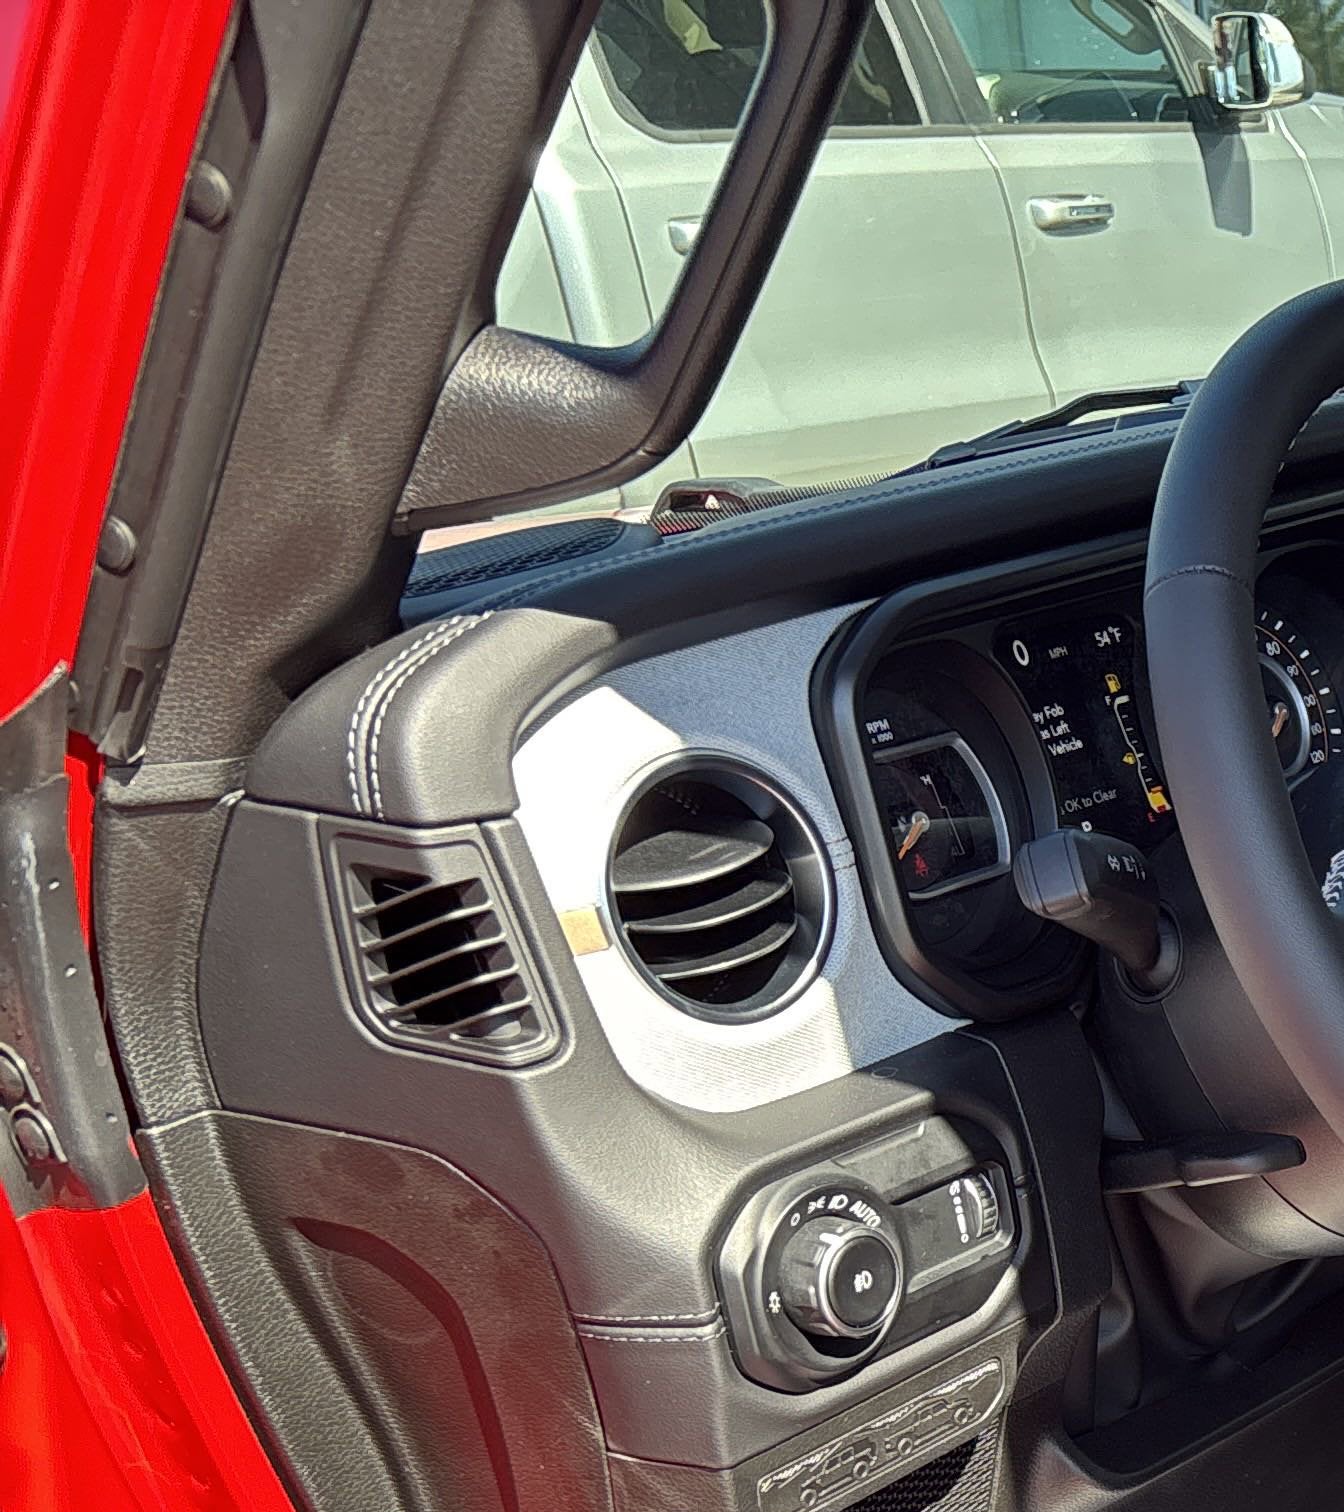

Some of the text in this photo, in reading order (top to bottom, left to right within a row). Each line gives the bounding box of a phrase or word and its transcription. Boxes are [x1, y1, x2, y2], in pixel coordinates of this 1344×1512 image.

[1048, 645, 1068, 660] MPH
[1266, 641, 1281, 656] 80
[1287, 664, 1299, 677] 90
[1043, 702, 1065, 718] Fob
[865, 718, 890, 735] RPM
[1050, 720, 1072, 738] Left
[1047, 736, 1084, 757] Vehicle
[1309, 750, 1325, 764] 120
[1064, 799, 1082, 814] OK
[1082, 796, 1094, 808] to
[1093, 788, 1118, 804] Clear
[849, 1199, 882, 1229] AUTO
